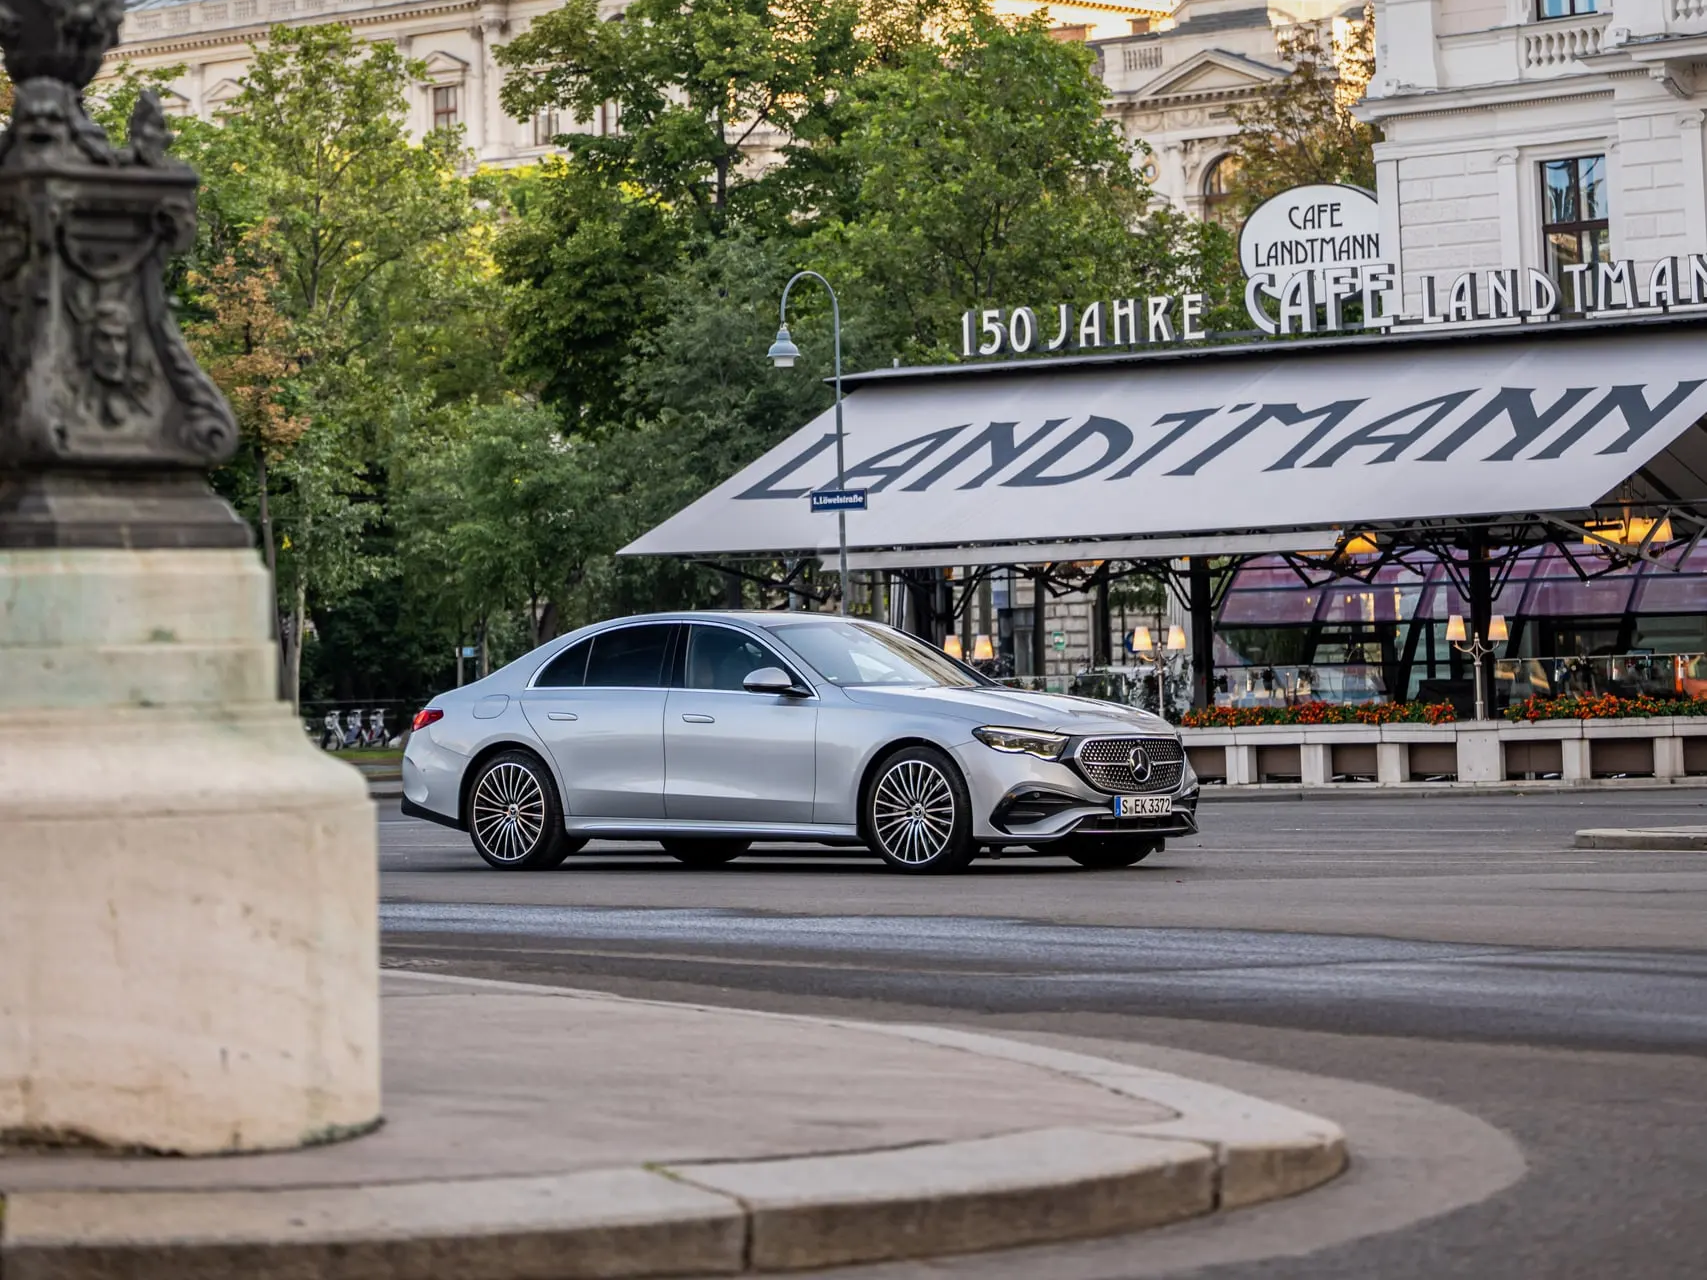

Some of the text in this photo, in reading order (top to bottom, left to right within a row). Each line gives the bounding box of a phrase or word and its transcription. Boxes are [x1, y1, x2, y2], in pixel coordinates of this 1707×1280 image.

[1288, 203, 1343, 230] CAFE
[1254, 233, 1380, 267] LANDTMANN
[961, 306, 1034, 356] 150
[1048, 293, 1207, 350] JAHRE
[1245, 264, 1395, 334] CAFE
[730, 379, 1707, 500] LANDTMANN
